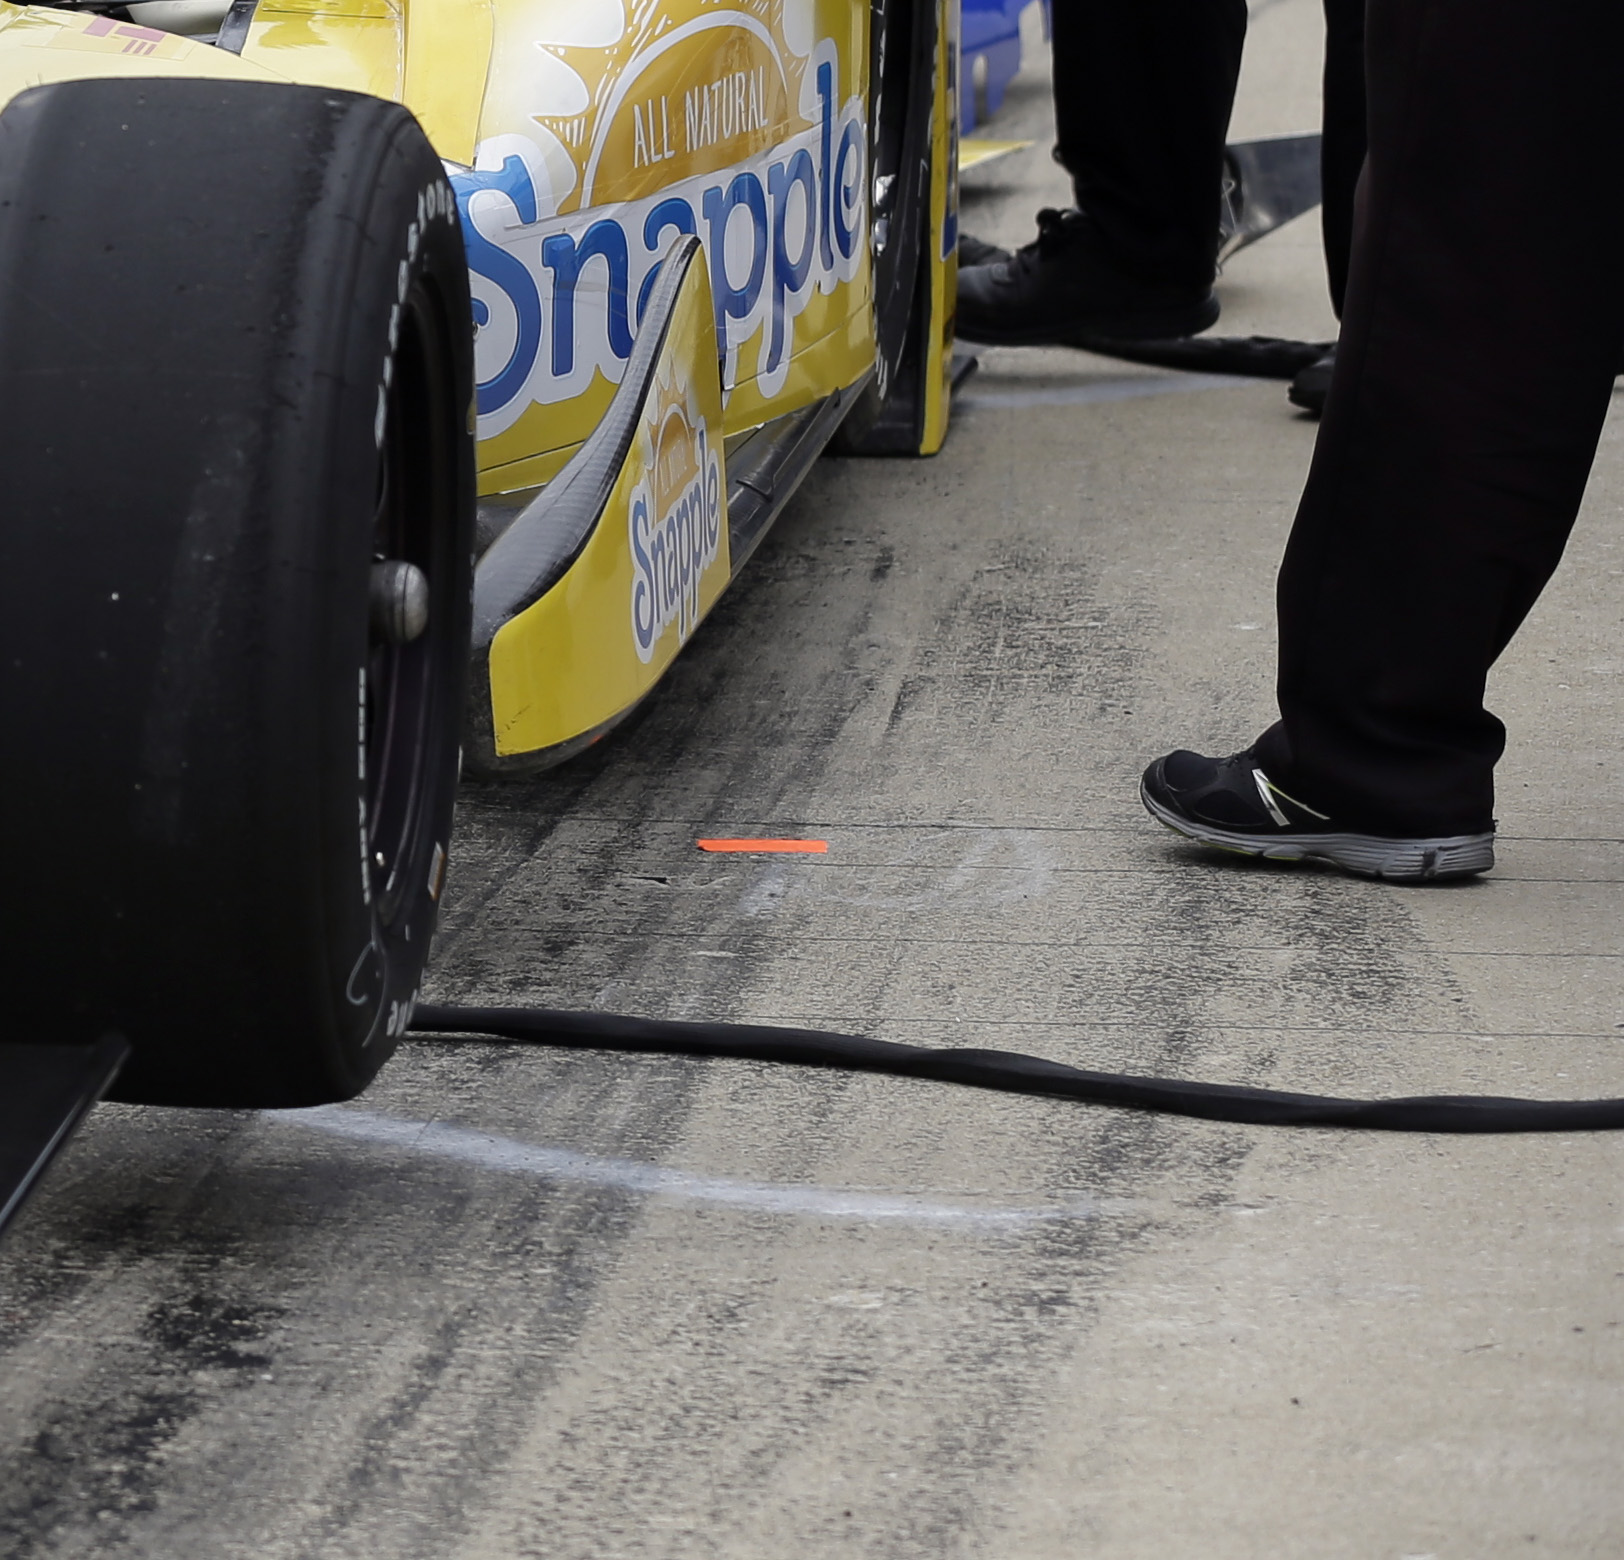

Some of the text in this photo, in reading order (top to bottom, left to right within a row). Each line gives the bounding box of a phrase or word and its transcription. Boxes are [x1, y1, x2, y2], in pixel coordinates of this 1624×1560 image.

[632, 70, 770, 168] ALL NATURAL
[454, 62, 864, 414] Snapple
[632, 428, 719, 648] Snapple
